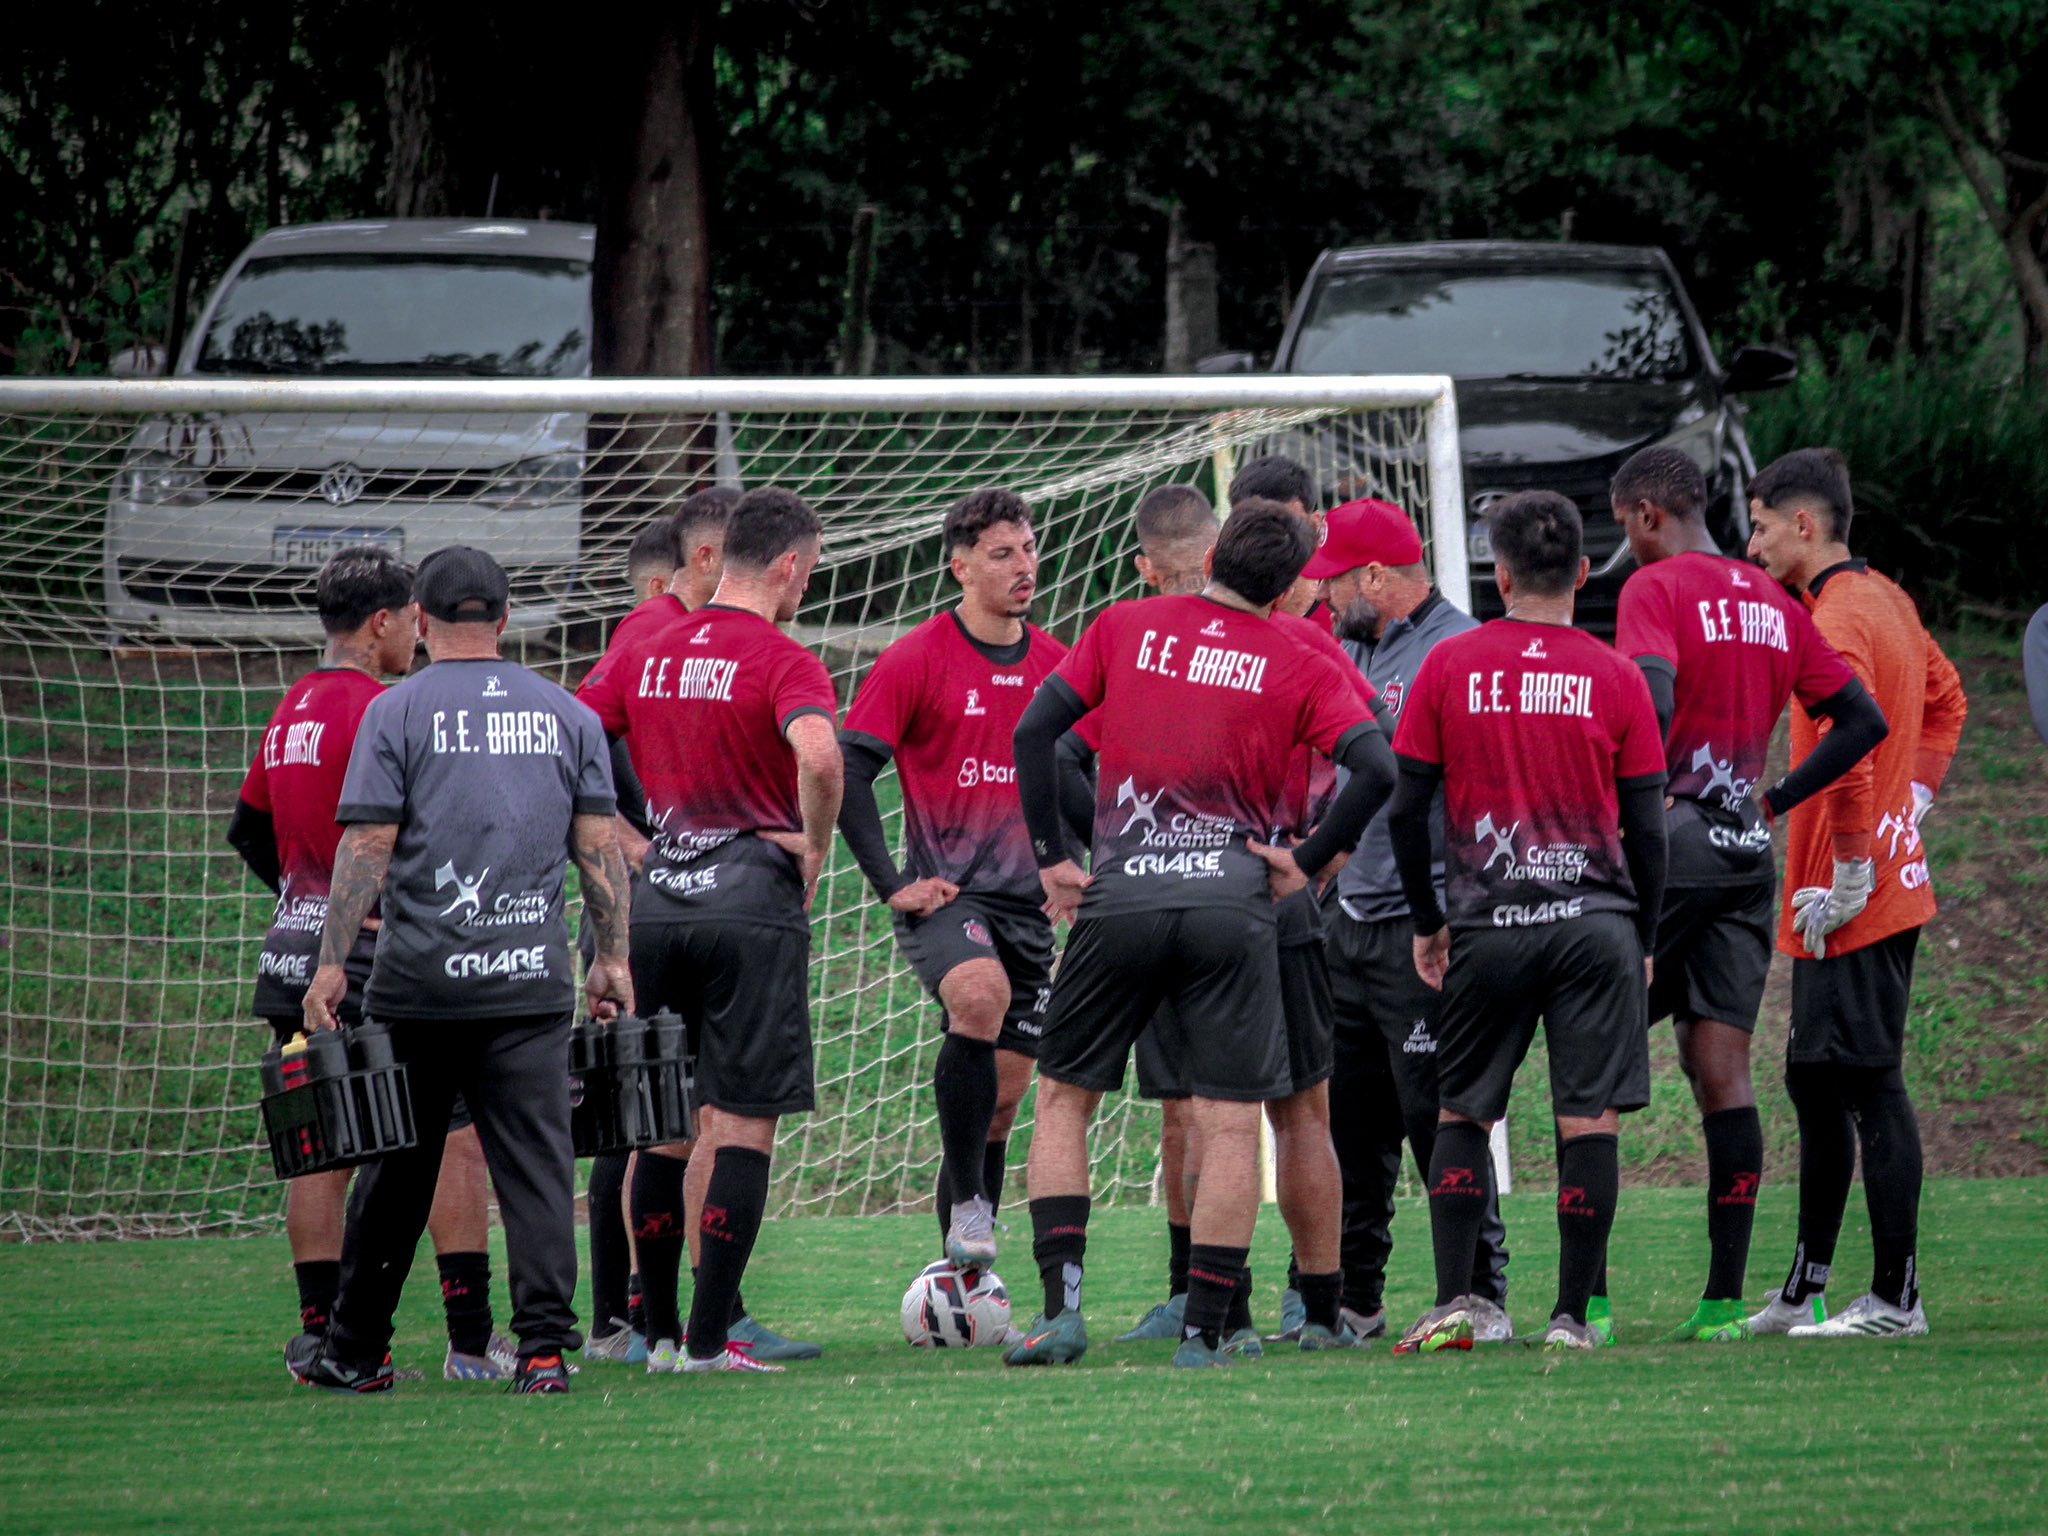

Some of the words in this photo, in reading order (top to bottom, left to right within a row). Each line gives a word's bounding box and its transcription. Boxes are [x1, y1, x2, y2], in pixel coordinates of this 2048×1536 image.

[1698, 599, 1736, 642] G.E.
[1738, 600, 1788, 653] BRASIL
[638, 657, 672, 698] G.E.
[678, 657, 738, 701] BRASIL
[1136, 629, 1178, 678] G.E.
[1187, 645, 1267, 694] BRASIL
[1468, 670, 1511, 714] G.E.
[1519, 671, 1593, 718] BRASIL
[433, 709, 480, 754] G.E.
[486, 711, 562, 756] BRASIL
[1123, 849, 1224, 877] CRIARE
[1492, 896, 1584, 927] CRIARE
[444, 944, 546, 978] CRIARE
